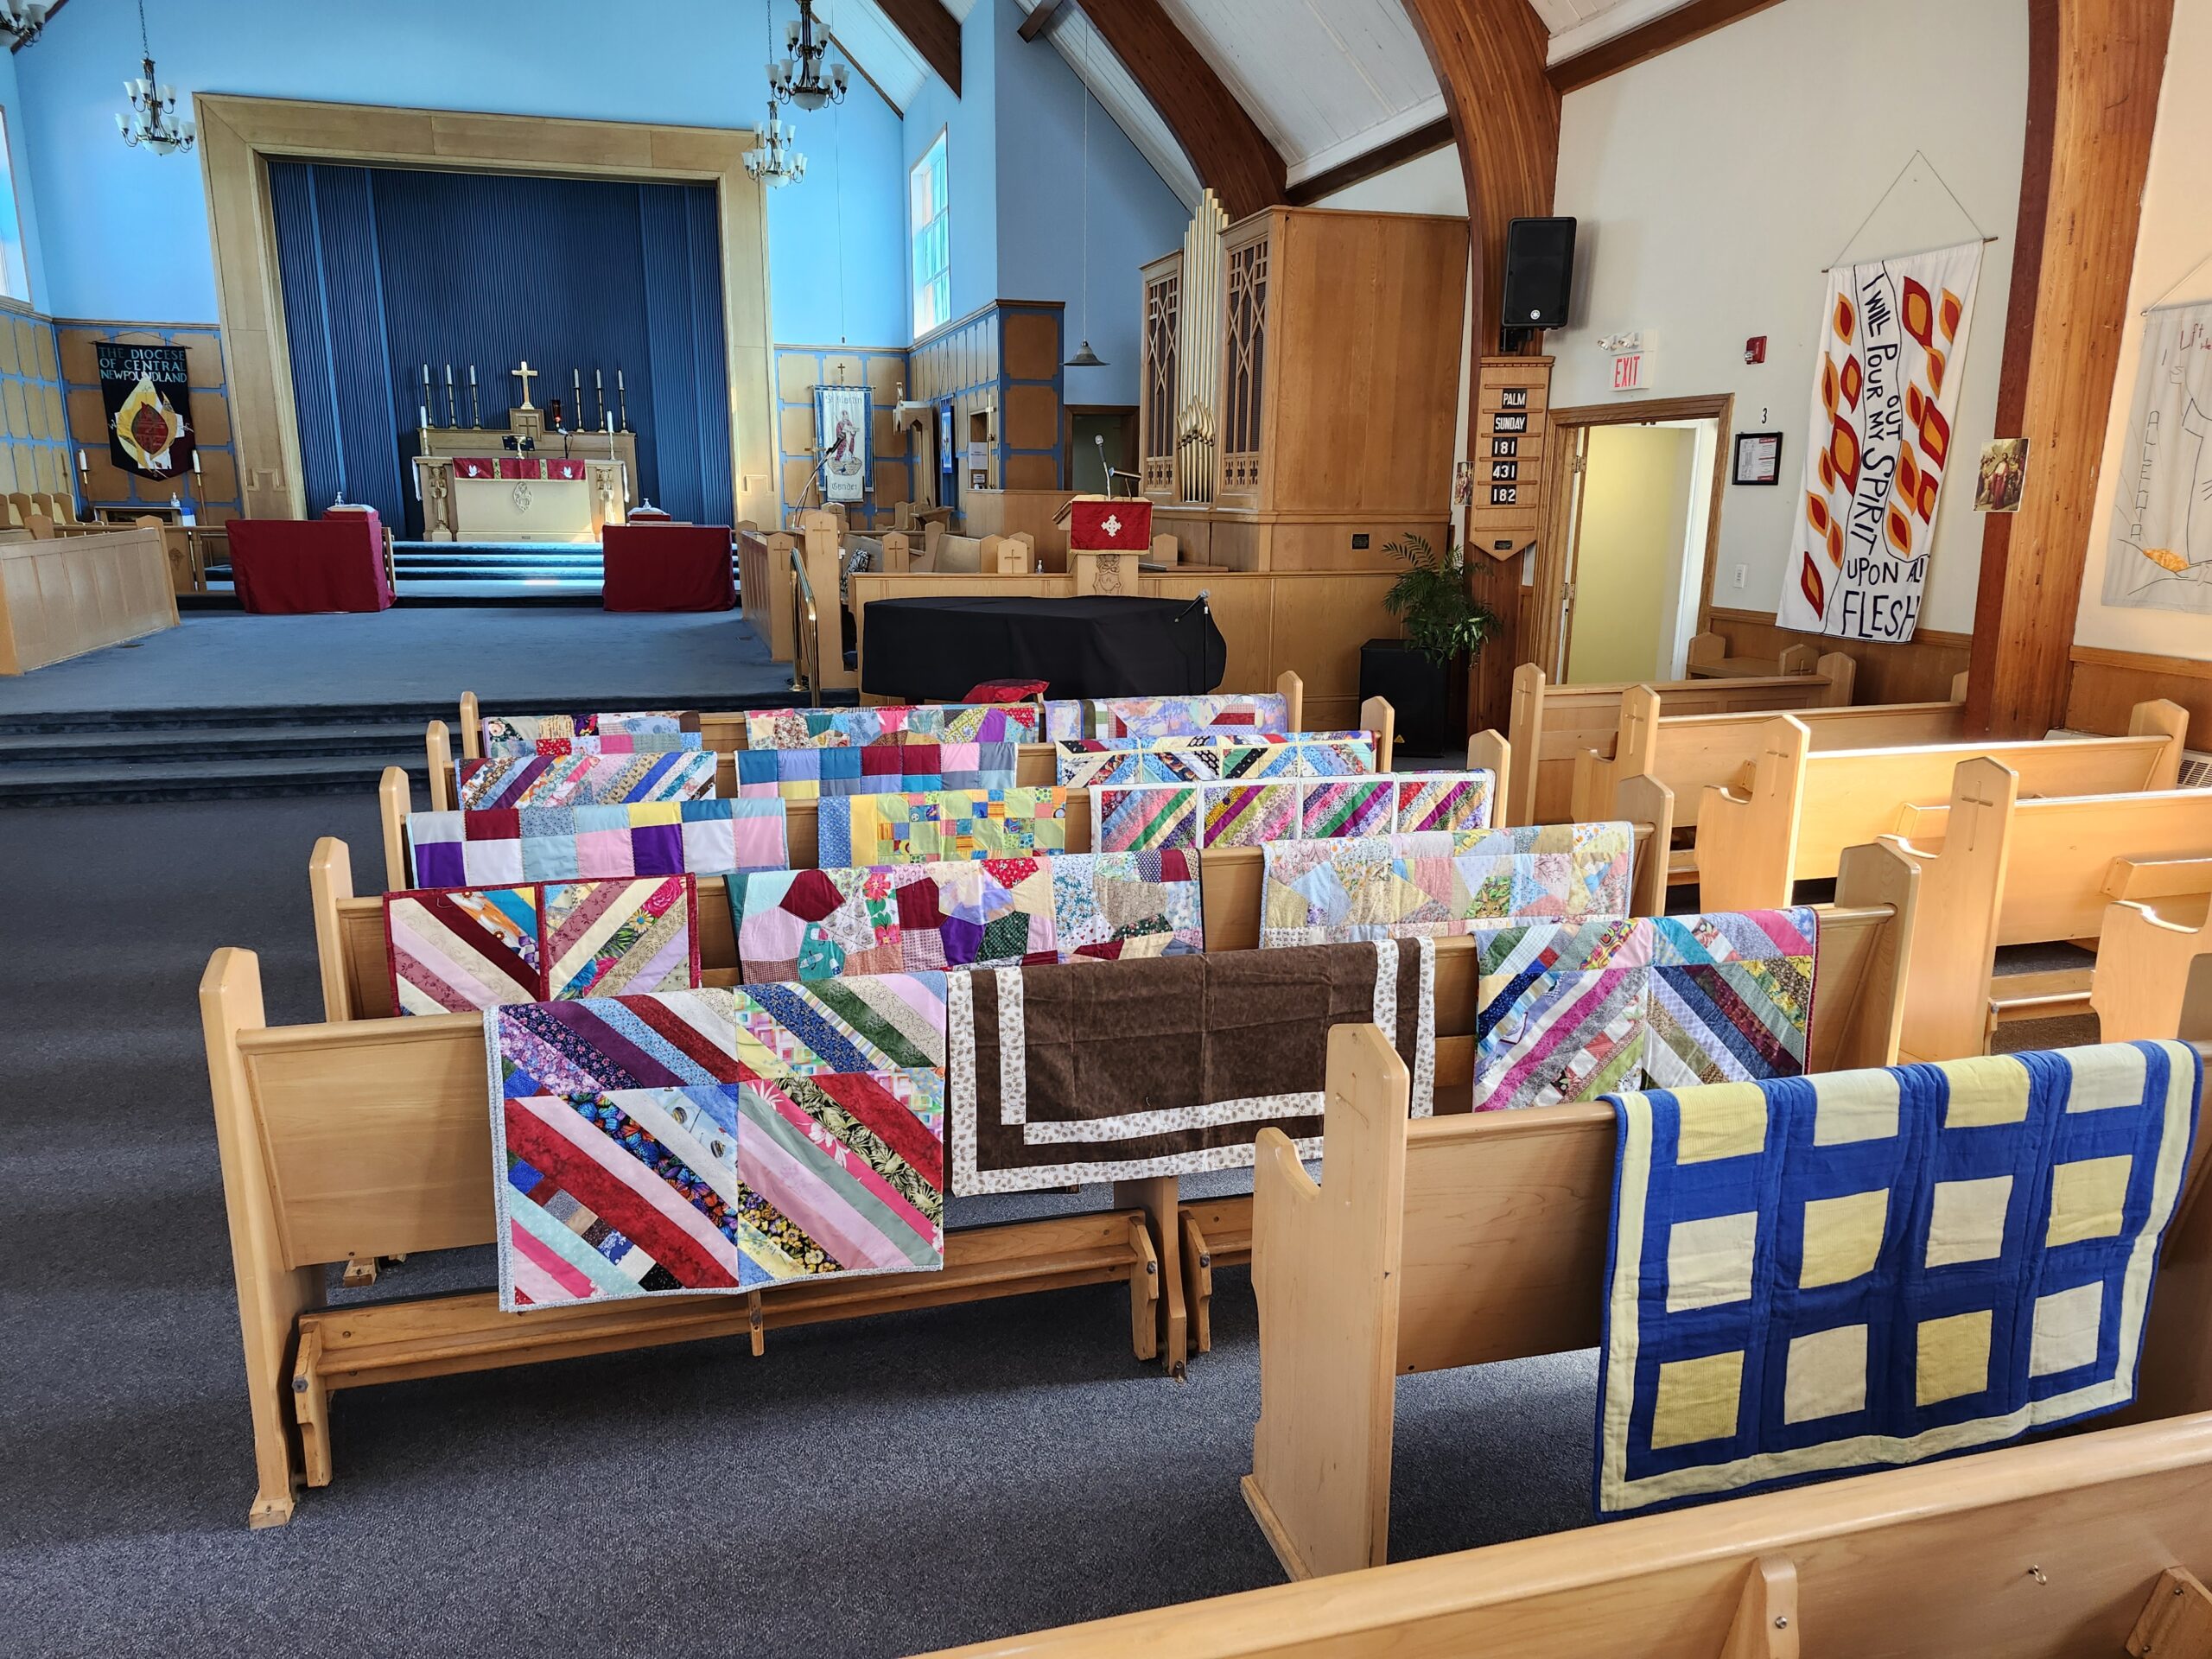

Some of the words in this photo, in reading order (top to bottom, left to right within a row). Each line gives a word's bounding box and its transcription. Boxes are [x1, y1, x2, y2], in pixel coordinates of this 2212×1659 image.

[1862, 272, 1885, 292] I
[1864, 289, 1891, 338] WILL
[98, 346, 124, 359] THE
[130, 348, 186, 361] DIOCESE
[99, 358, 116, 369] OF
[124, 359, 186, 372] CENTRAL
[1614, 355, 1640, 388] EXIT
[1866, 343, 1898, 401] POUR
[100, 369, 188, 383] NEWFOUNDLAND
[1503, 392, 1526, 406] PALM
[1495, 416, 1526, 430] SUNDAY
[1761, 407, 1768, 424] 3
[1885, 395, 1903, 441] OUT
[1868, 410, 1885, 441] MY
[1494, 441, 1515, 454] 181
[1492, 464, 1516, 478] 431
[1493, 488, 1516, 502] 182
[1850, 447, 1896, 556] SPIRIT
[1847, 557, 1899, 586] UPON
[1841, 589, 1921, 640] FLESH
